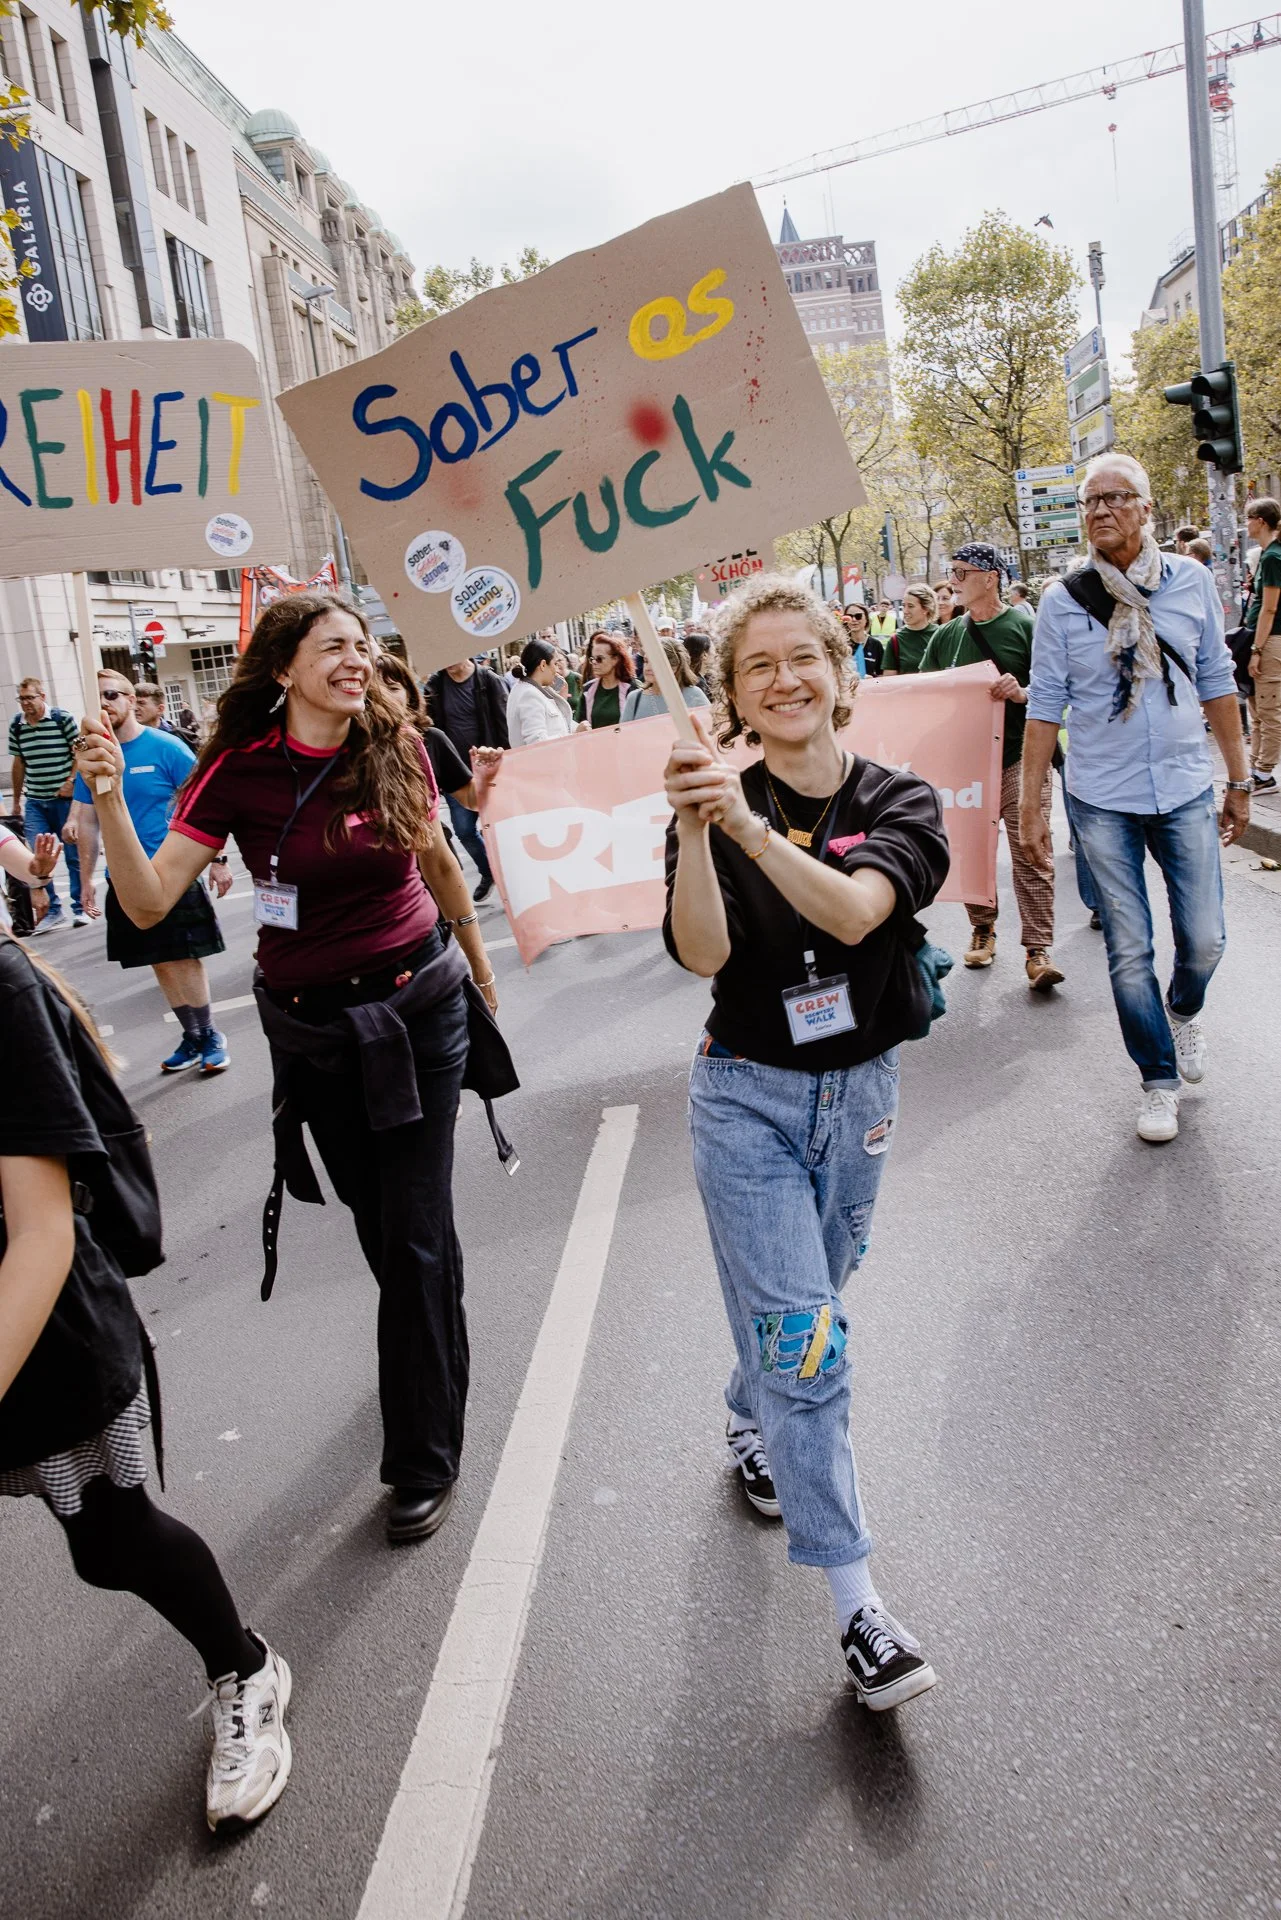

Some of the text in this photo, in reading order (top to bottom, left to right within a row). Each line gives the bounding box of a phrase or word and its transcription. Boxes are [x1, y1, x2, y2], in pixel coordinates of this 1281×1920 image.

[13, 180, 42, 277] GALERIA
[353, 327, 598, 502] Sober
[454, 575, 492, 606] sober.
[463, 585, 504, 618] strong.
[937, 781, 983, 809] nd
[495, 790, 668, 919] RE
[260, 892, 290, 906] CREW
[795, 992, 839, 1014] CREW
[806, 1012, 836, 1026] WALK
